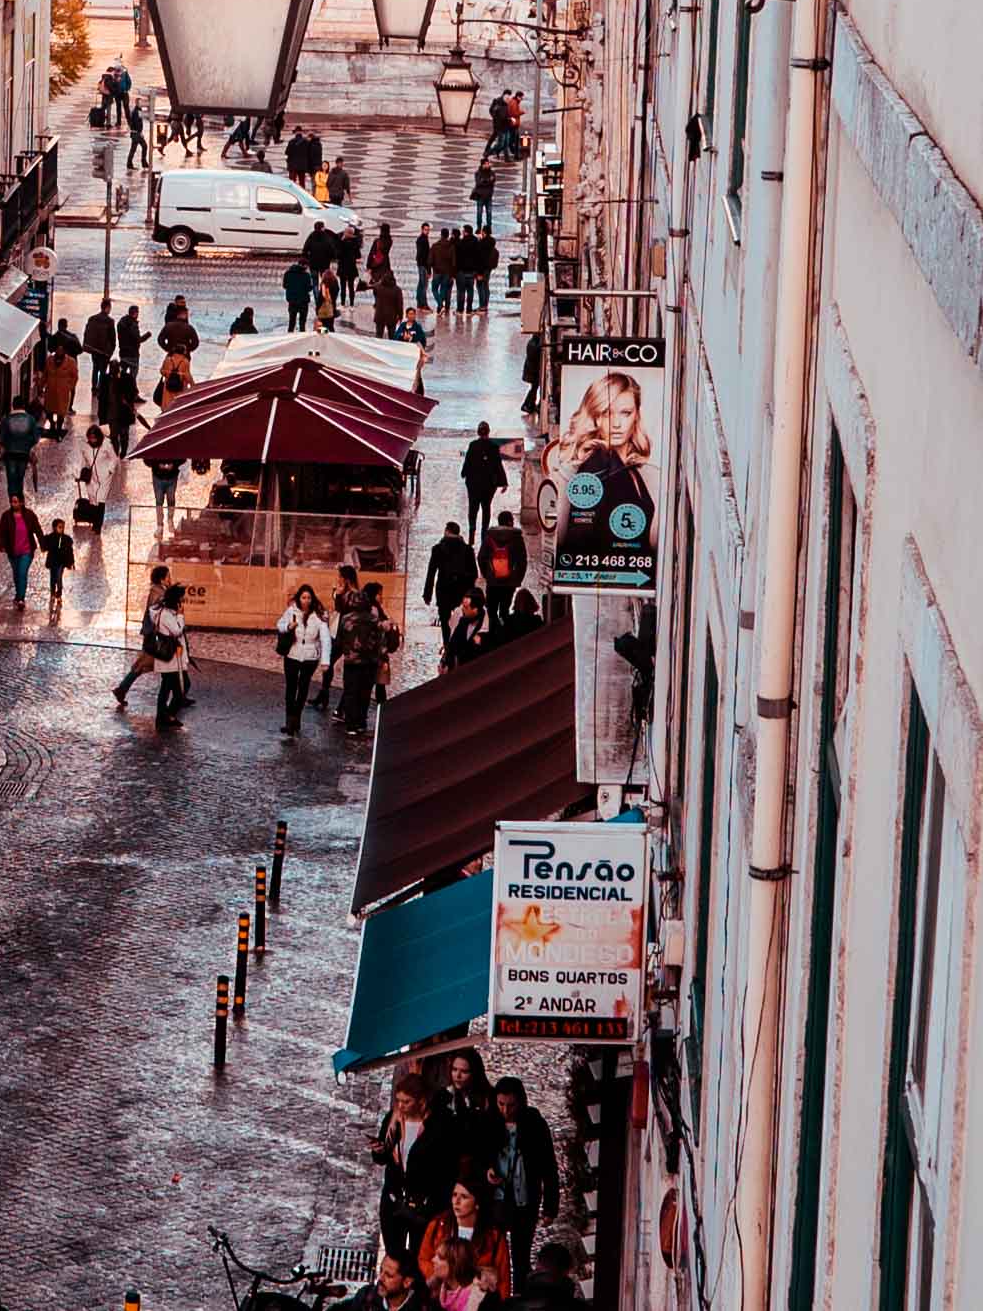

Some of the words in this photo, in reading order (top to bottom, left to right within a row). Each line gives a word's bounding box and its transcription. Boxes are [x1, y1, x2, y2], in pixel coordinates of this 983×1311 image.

[568, 342, 612, 361] HAIR
[575, 554, 599, 566] 213
[601, 555, 626, 567] 468
[628, 556, 653, 568] 268
[508, 839, 635, 882] Pensão
[508, 884, 633, 902] RESIDENCIAL
[508, 969, 549, 983] BONS
[556, 971, 628, 985] QUARTOS
[538, 997, 596, 1013] ANDAR
